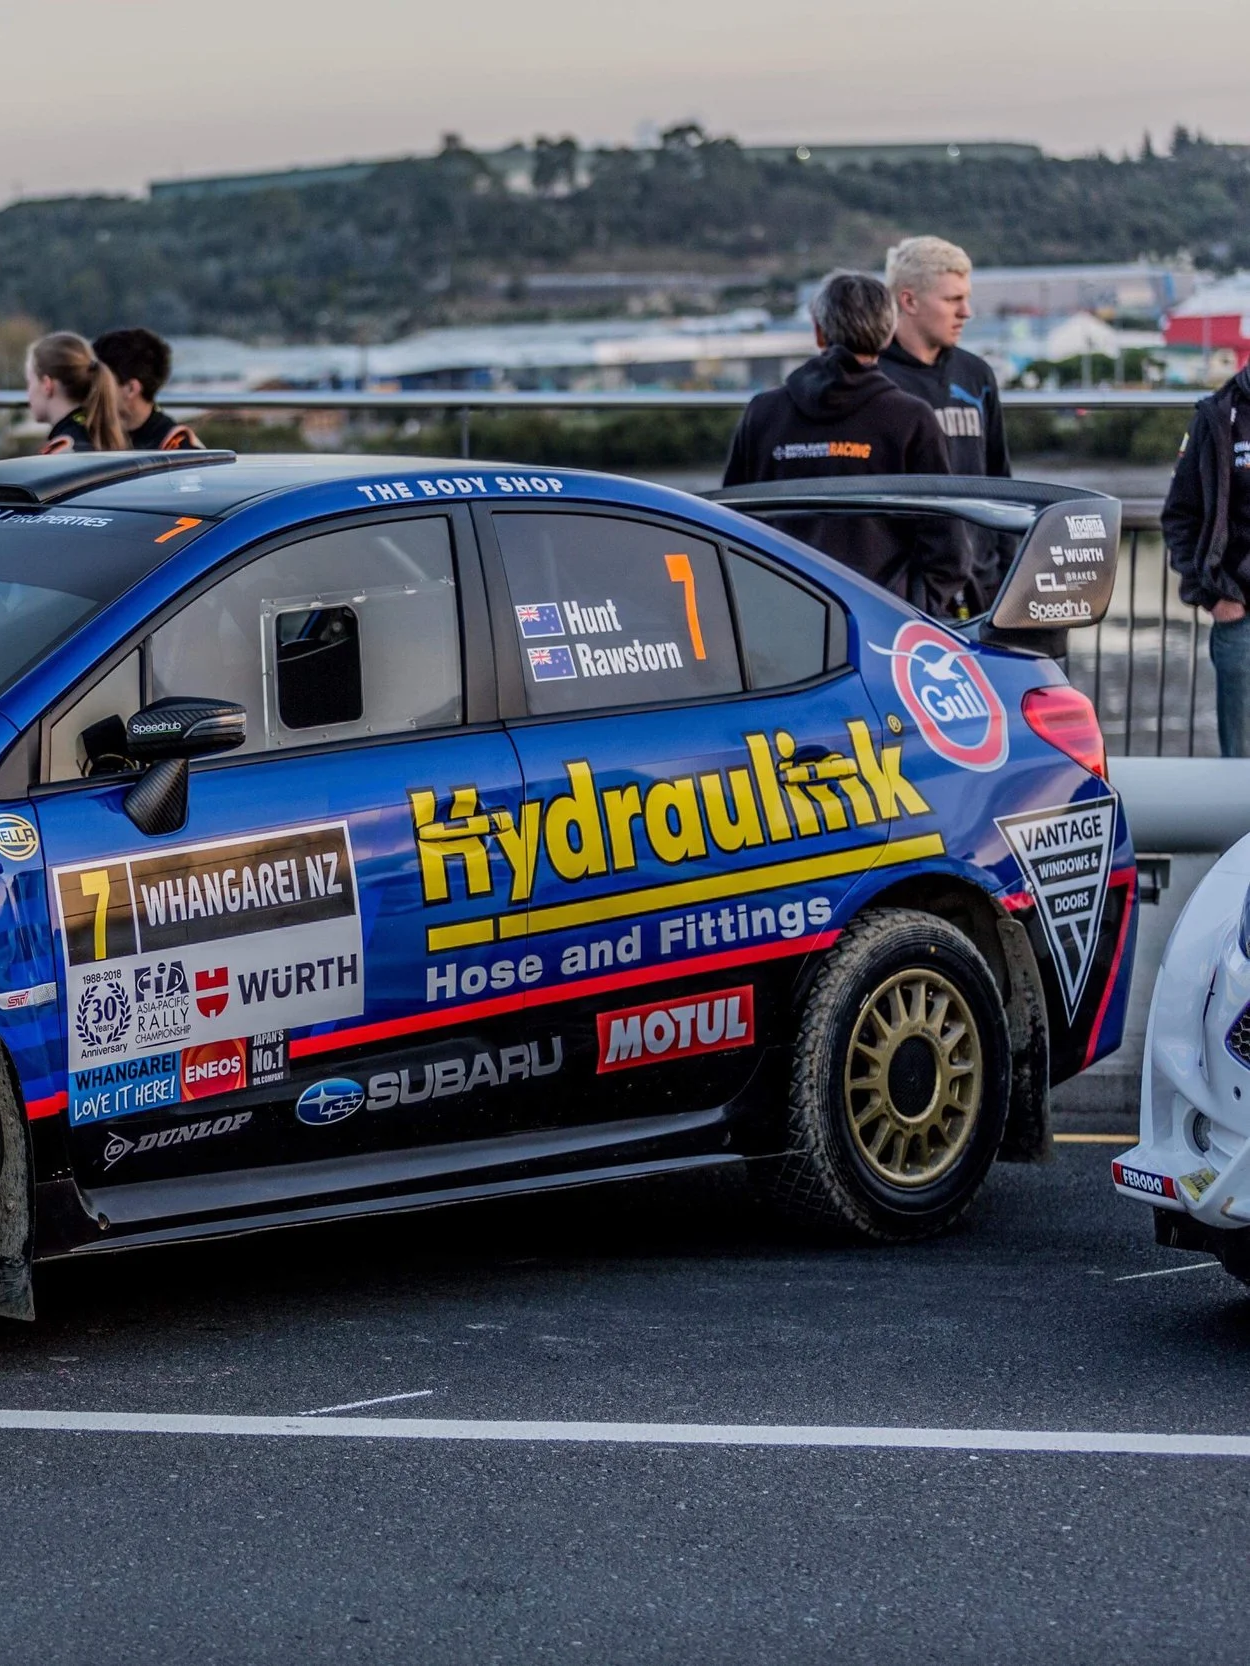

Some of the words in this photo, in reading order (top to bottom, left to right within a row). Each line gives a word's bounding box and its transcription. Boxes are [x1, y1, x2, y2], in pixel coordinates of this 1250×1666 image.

[357, 482, 414, 502] THE
[417, 477, 488, 496] BODY
[495, 477, 564, 493] SHOP
[3, 513, 114, 528] PROPERTIES
[154, 516, 203, 544] 7
[1035, 573, 1067, 592] CL
[1066, 571, 1097, 581] BRAKES
[562, 599, 622, 636] Hunt
[664, 553, 707, 660] 7
[1029, 599, 1092, 622] Speedhub
[576, 639, 684, 678] Rawstorn
[920, 680, 989, 723] Gull
[132, 721, 182, 735] Speedhub
[410, 718, 933, 903] Hydraulink
[1019, 815, 1103, 852] VANTAGE
[1039, 854, 1091, 879] WINDOWS
[1091, 852, 1099, 867] &
[80, 869, 110, 961] 7
[141, 858, 301, 926] WHANGAREI
[305, 852, 343, 898] NZ
[1055, 892, 1089, 913] DOORS
[426, 955, 543, 1003] Hose
[561, 933, 642, 976] and
[660, 896, 833, 955] Fittings
[83, 969, 122, 985] 1988-2018
[92, 996, 117, 1024] 30
[137, 995, 190, 1015] ASIA-PACIFIC
[94, 1022, 115, 1034] Years
[138, 1007, 189, 1033] RALLY
[605, 996, 748, 1064] MOTUL
[135, 1025, 192, 1044] CHAMPIONSHIP
[253, 1030, 284, 1046] JAPAN'S
[81, 1042, 128, 1060] Anniversary
[252, 1044, 284, 1073] No.1
[75, 1052, 176, 1091] WHANGAREI
[185, 1055, 241, 1084] ENEOS
[366, 1035, 564, 1112] SUBARU
[74, 1092, 111, 1121] LOVE
[115, 1084, 133, 1110] IT
[135, 1075, 175, 1105] HERE!
[133, 1111, 253, 1153] DUNLOP
[1122, 1168, 1163, 1194] FERODO
